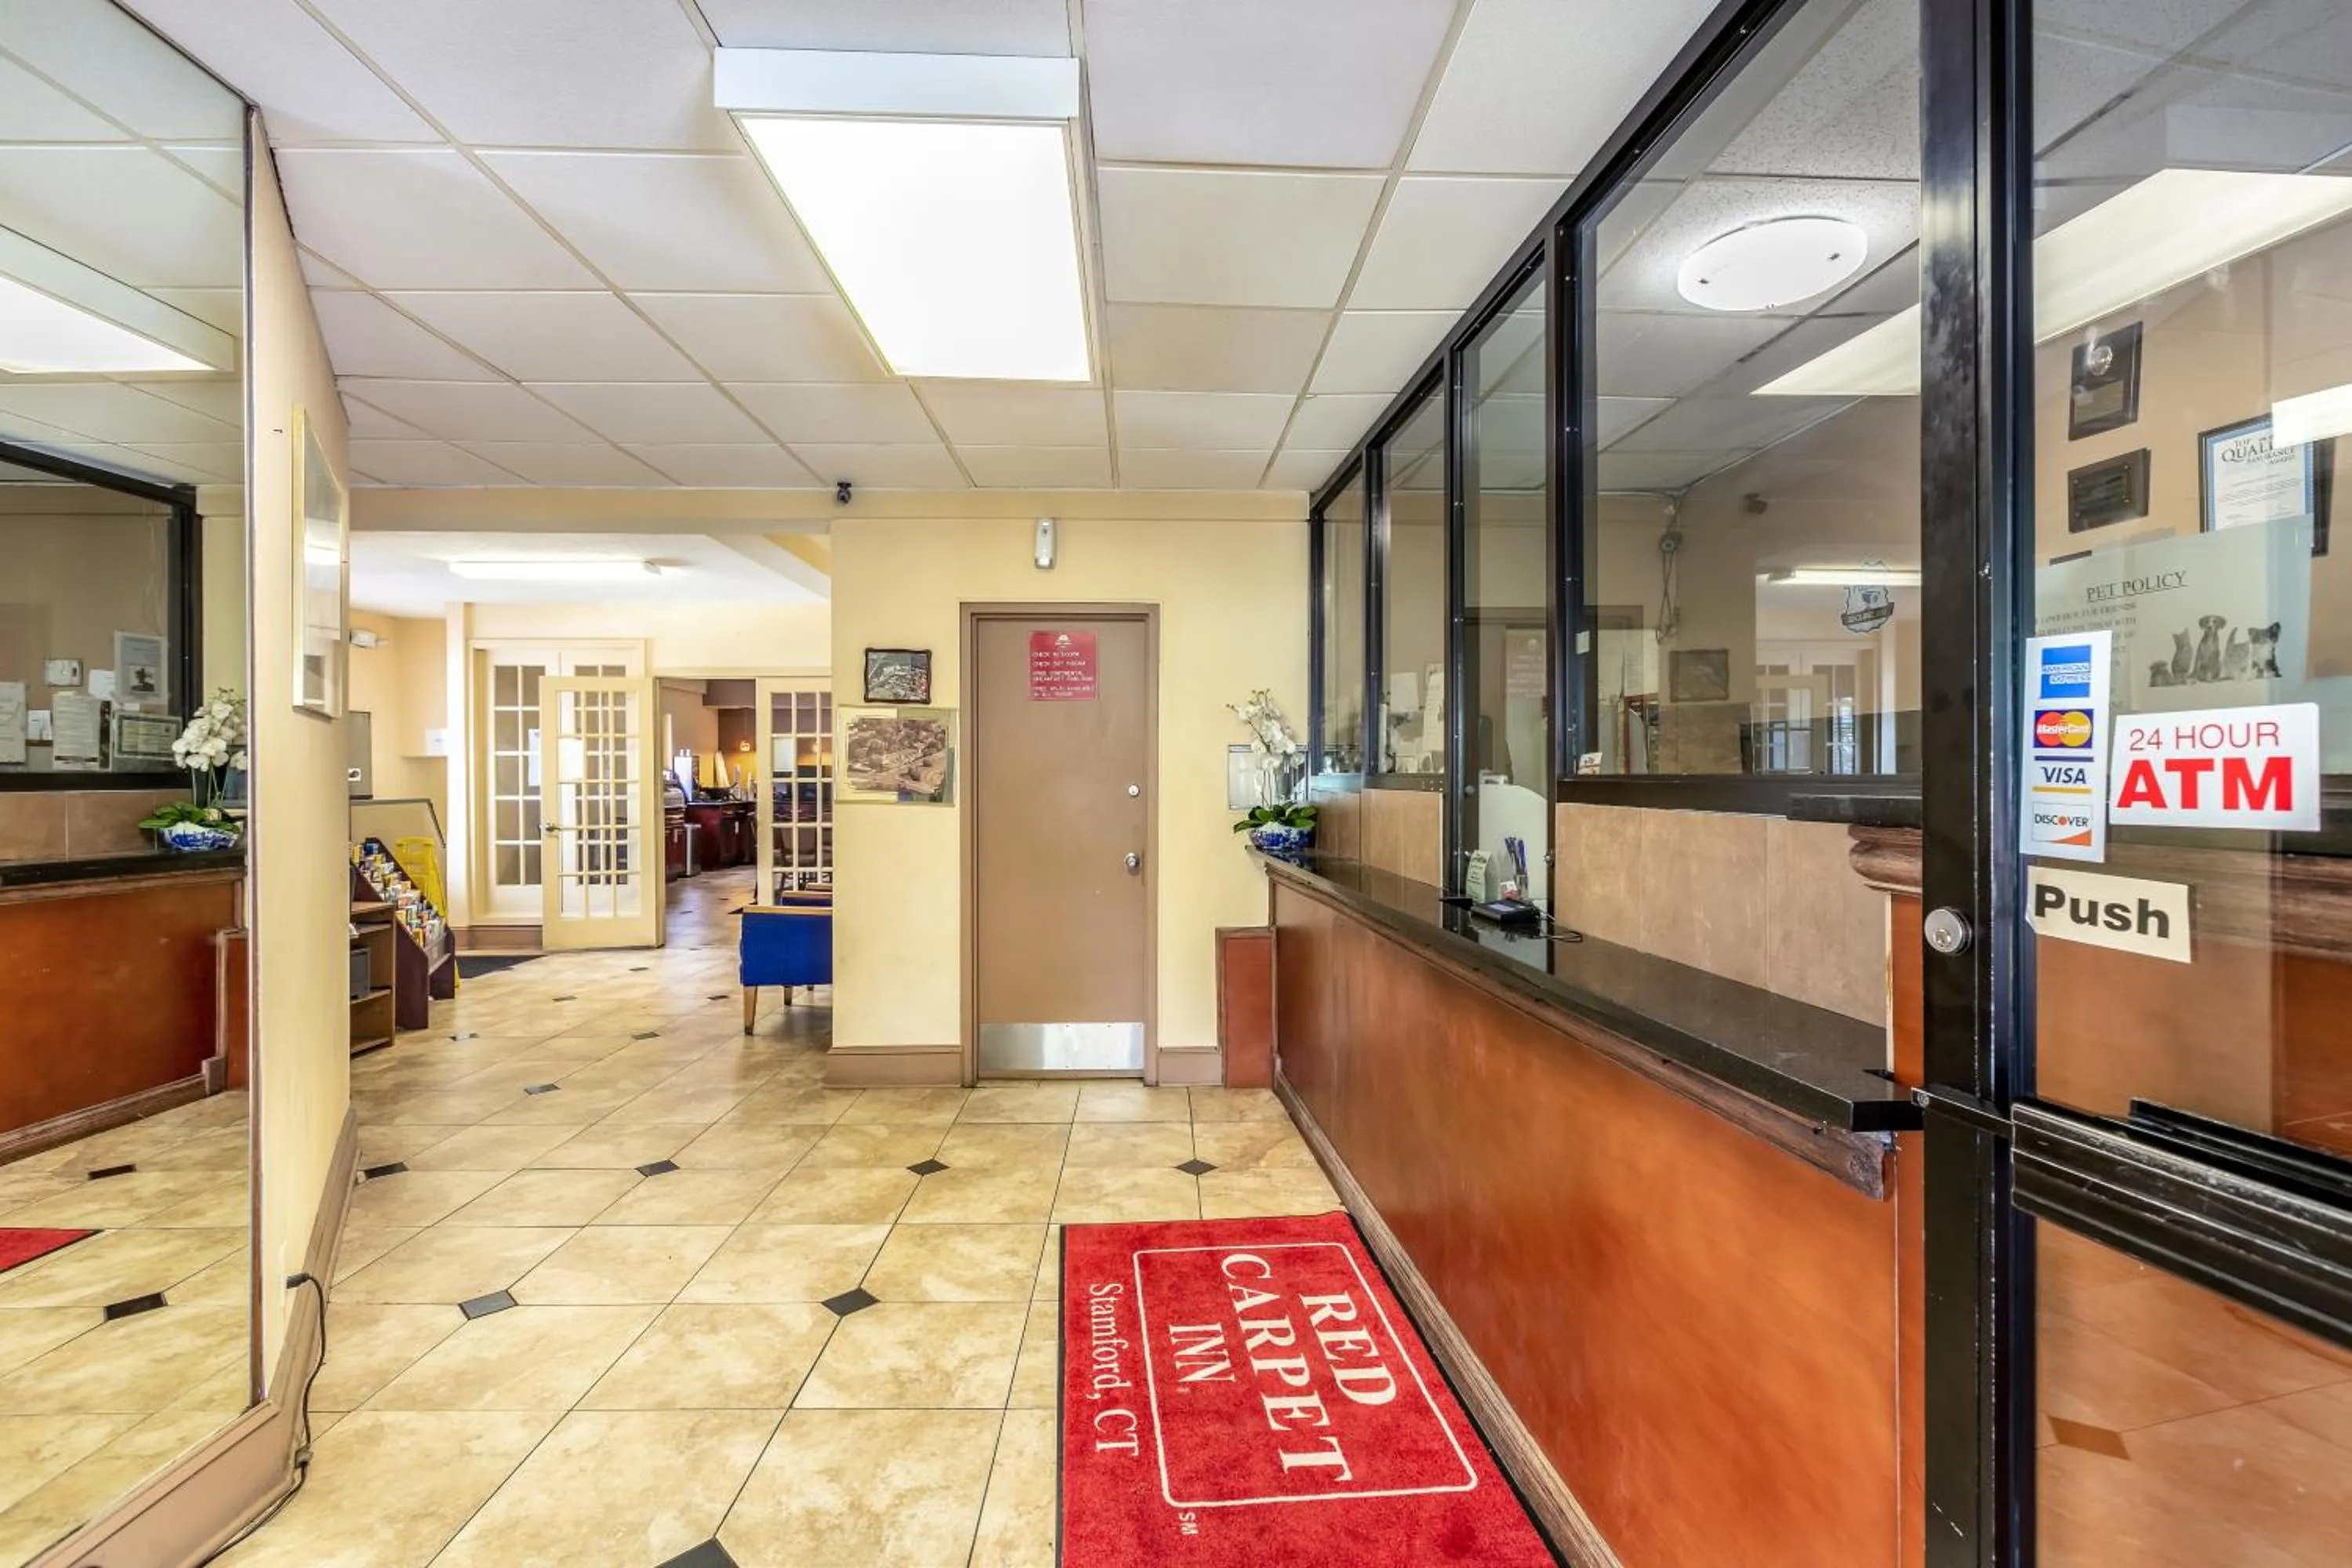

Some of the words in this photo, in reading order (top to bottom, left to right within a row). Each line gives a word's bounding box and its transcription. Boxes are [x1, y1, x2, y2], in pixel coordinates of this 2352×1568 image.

[2221, 434, 2273, 463] QUALI
[2086, 583, 2117, 602] PET
[2122, 571, 2187, 596] POLICY
[2129, 728, 2163, 751] 24
[2176, 722, 2280, 749] HOUR
[2040, 766, 2086, 784] VISA
[2116, 756, 2293, 811] ATM
[2034, 813, 2089, 827] DISCOVER
[2034, 884, 2170, 939] Push
[1087, 1283, 1131, 1399] Stamford,
[1169, 1321, 1236, 1382] INN
[1298, 1290, 1396, 1406] RED
[1221, 1253, 1352, 1482] CARPET
[1094, 1409, 1139, 1457] CT
[1179, 1512, 1199, 1535] SM
